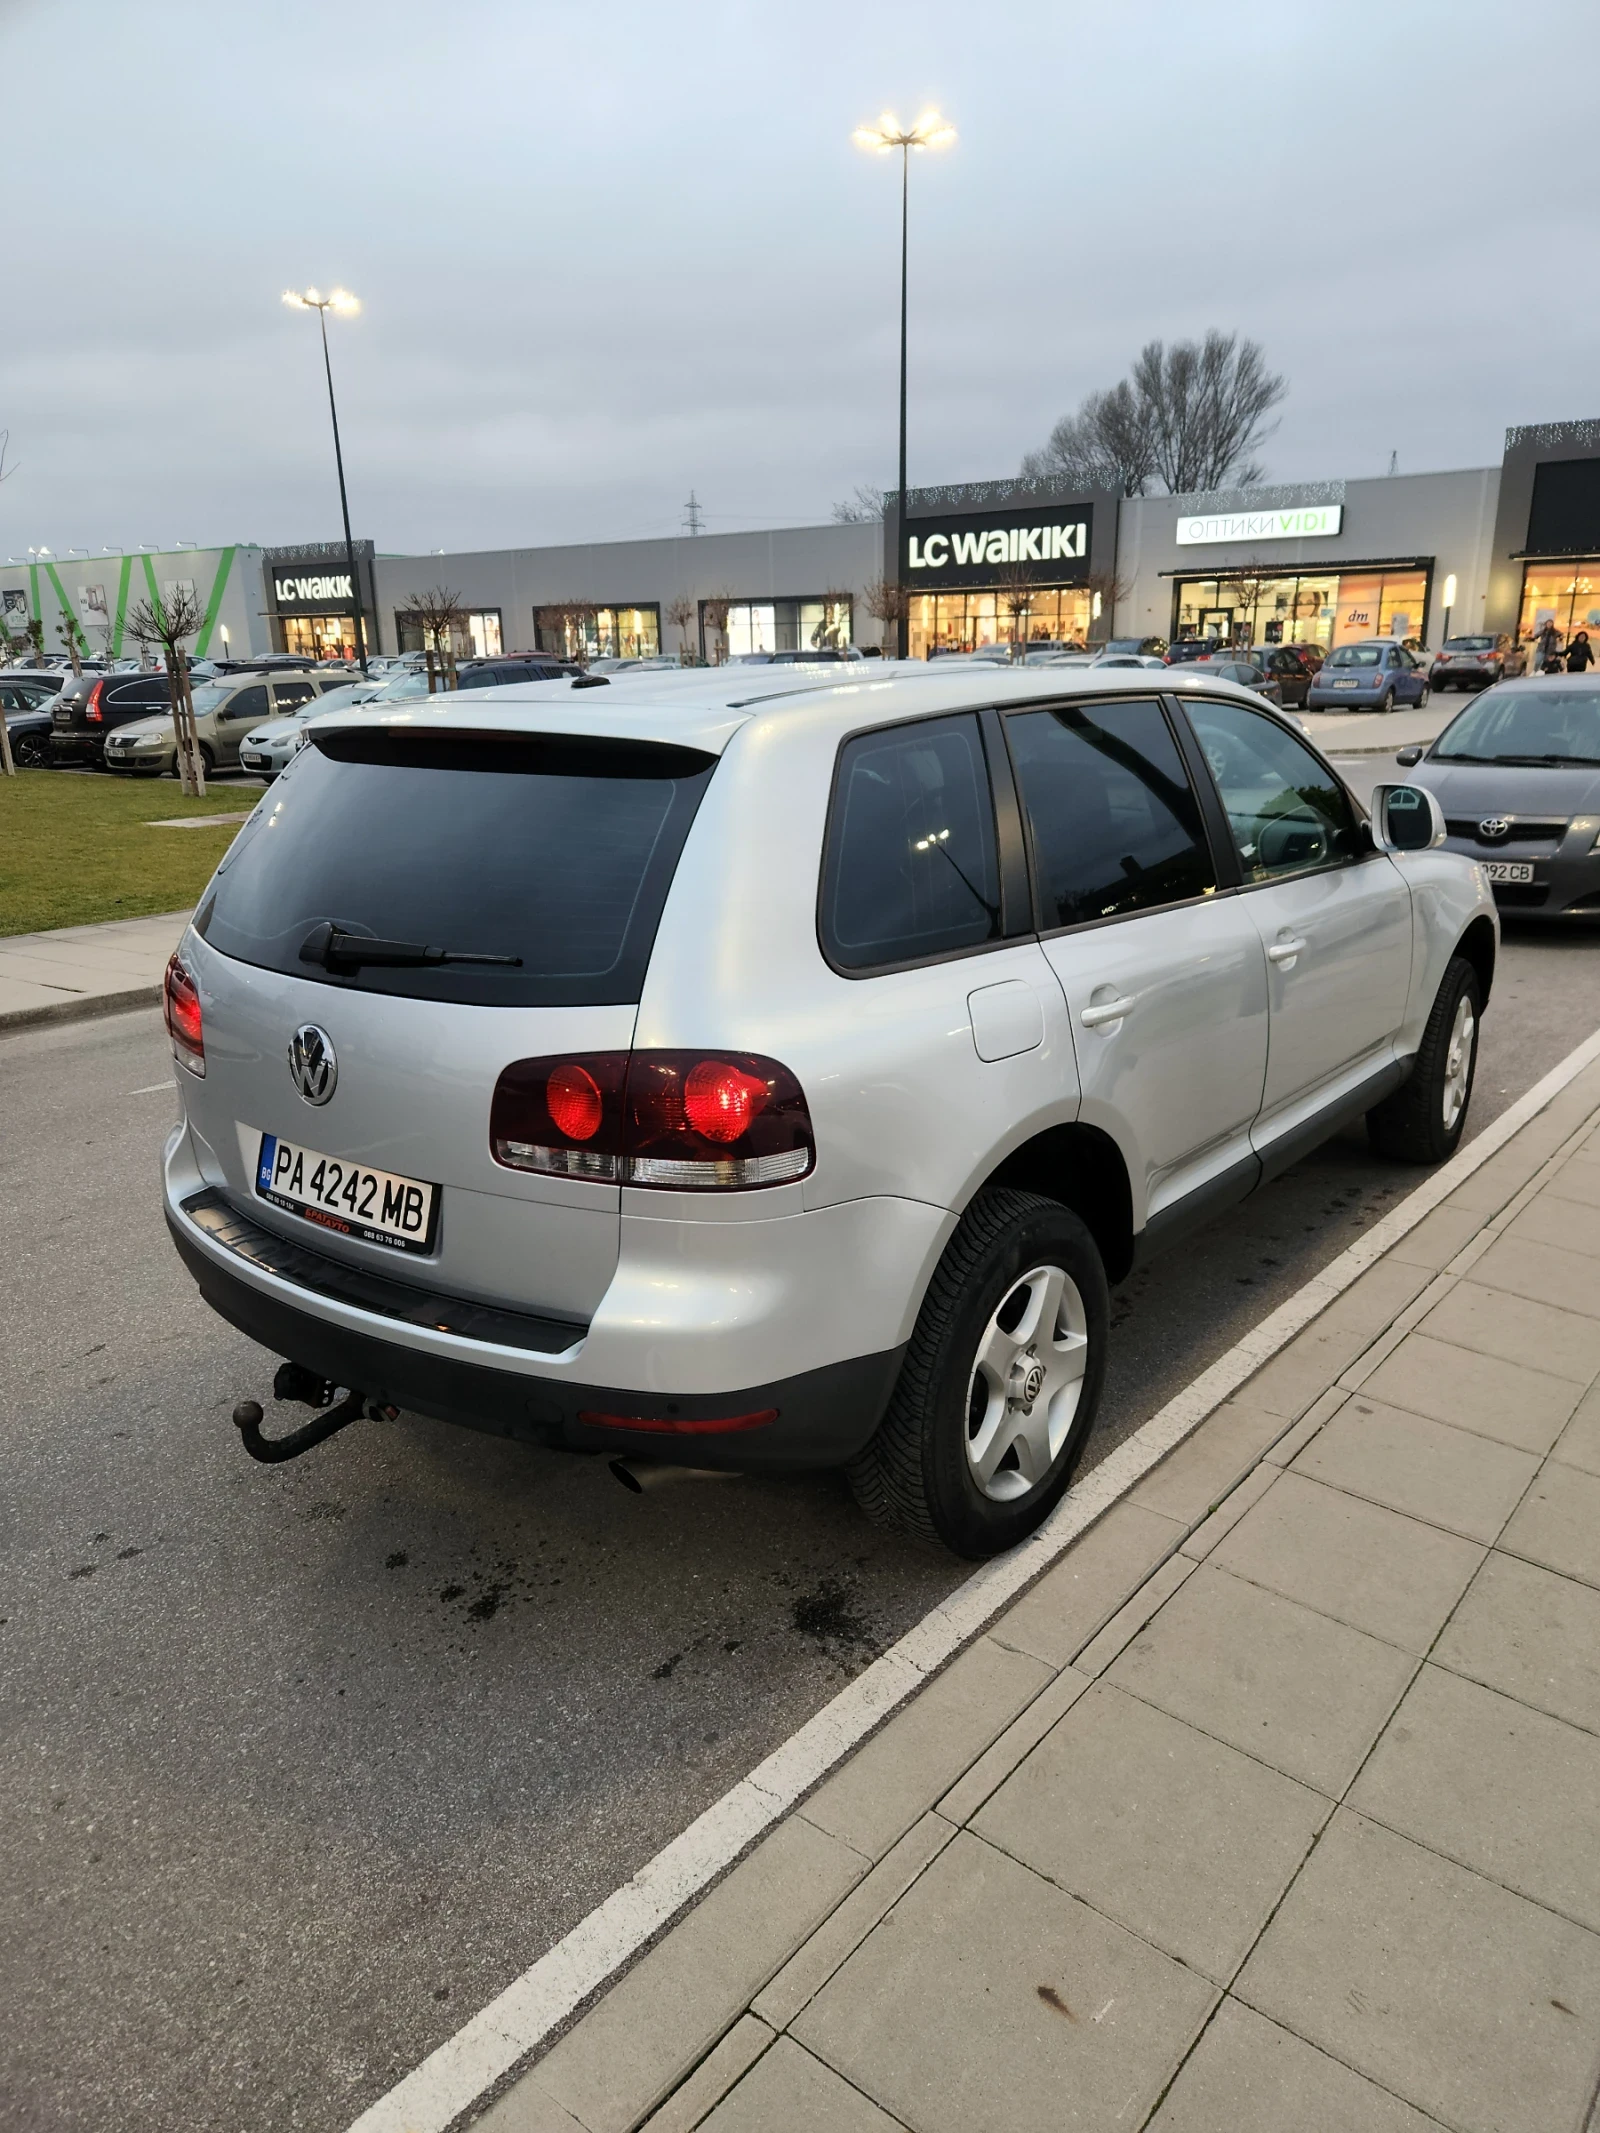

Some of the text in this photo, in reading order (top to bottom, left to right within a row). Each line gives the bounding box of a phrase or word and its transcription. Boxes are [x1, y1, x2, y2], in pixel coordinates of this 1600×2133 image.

[1189, 512, 1327, 539] ОПТИКИ VIDI
[909, 534, 949, 568] LC
[275, 579, 296, 601] LC
[1348, 609, 1368, 623] dm
[1510, 866, 1530, 880] CB
[261, 1166, 272, 1181] BG
[274, 1144, 424, 1232] PA 4242 MB
[305, 1207, 350, 1233] БРАТ АУТО
[363, 1230, 375, 1239] 088
[376, 1234, 384, 1242] 63
[385, 1236, 393, 1244] 76
